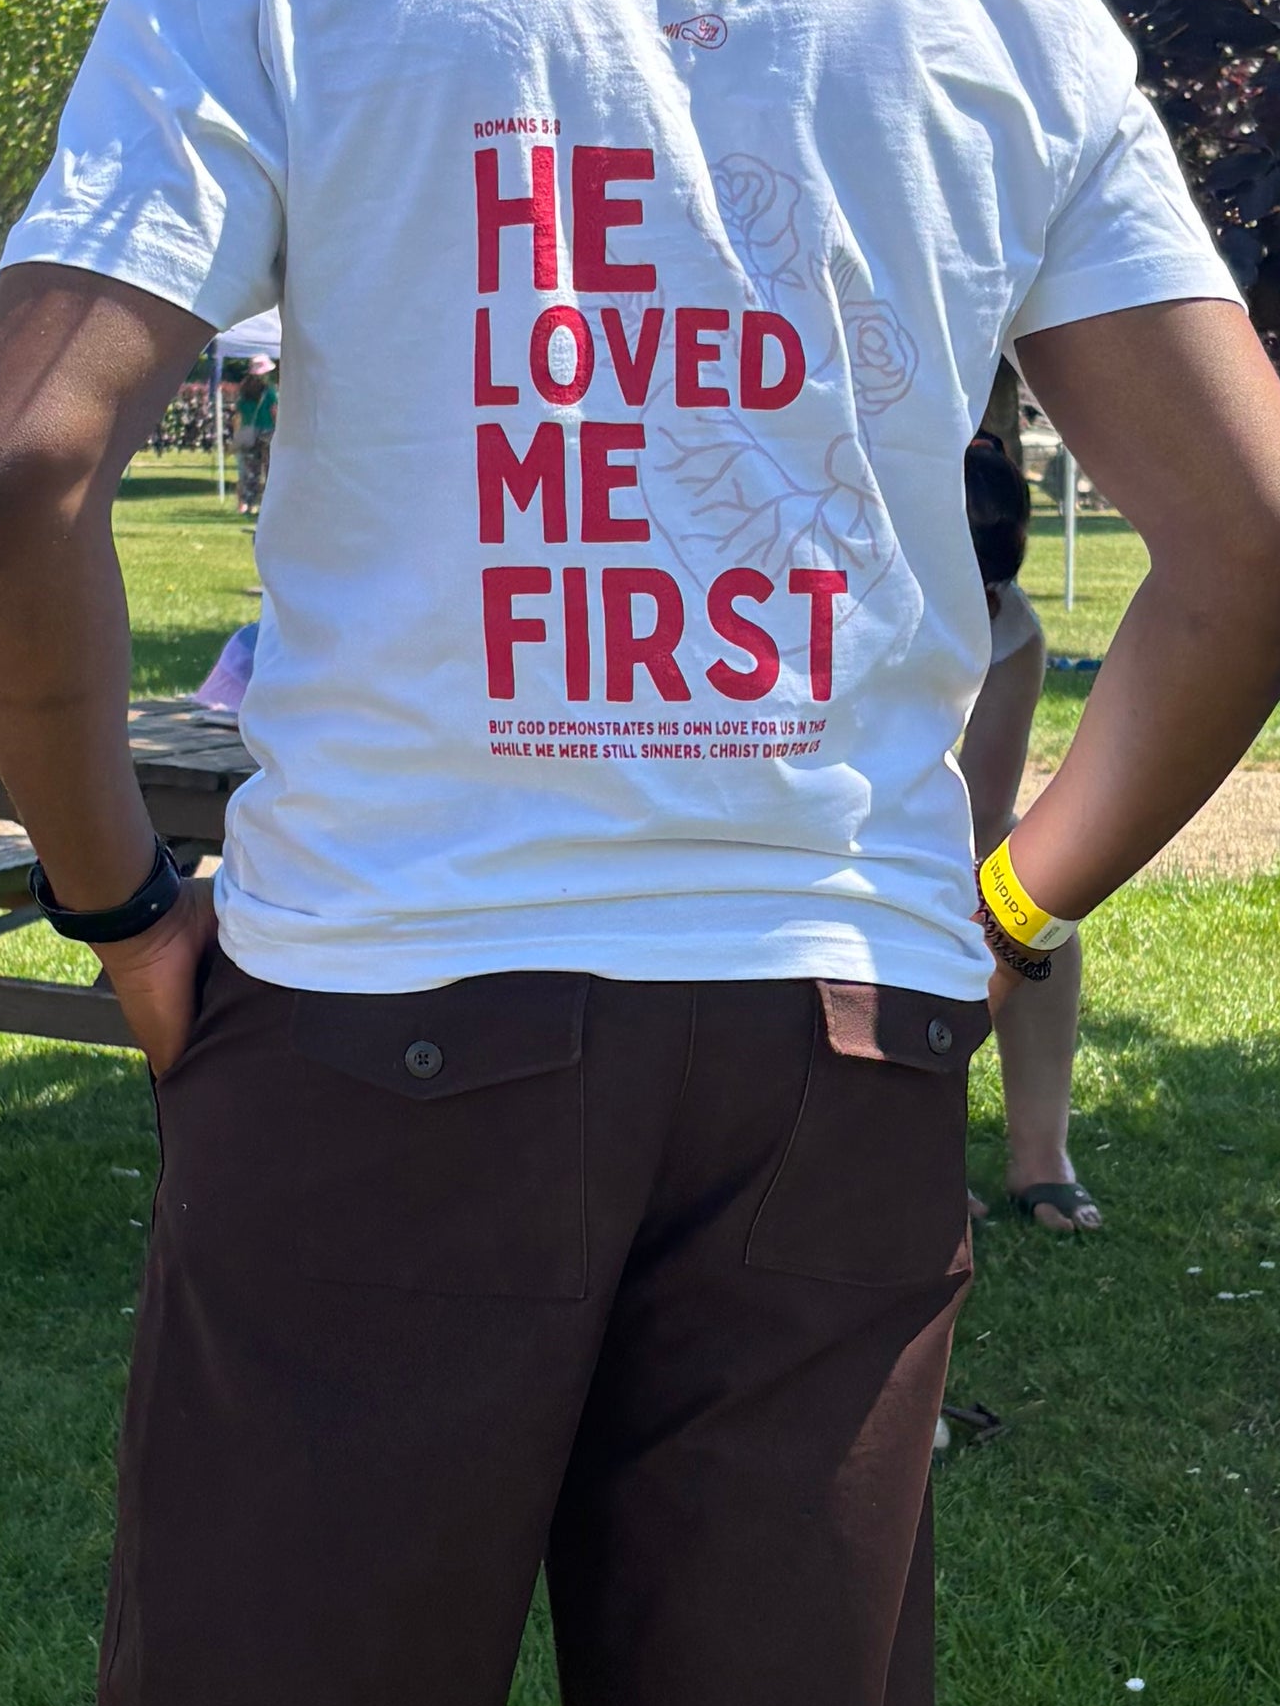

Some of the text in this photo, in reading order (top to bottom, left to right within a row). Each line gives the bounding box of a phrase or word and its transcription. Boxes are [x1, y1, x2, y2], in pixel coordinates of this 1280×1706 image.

[474, 117, 561, 139] ROMANS 5:8
[474, 145, 657, 293] HE
[473, 305, 806, 410] LOVED
[476, 422, 651, 544] ME
[481, 566, 848, 702] FIRST
[489, 720, 513, 734] BUT
[518, 720, 545, 735] GOD
[549, 721, 655, 735] DEMONSTRATES
[658, 721, 679, 735] HIS
[683, 721, 712, 735] OWN
[715, 721, 748, 735] LOVE
[752, 721, 777, 735] FOR
[780, 720, 794, 734] US
[797, 721, 806, 734] IN
[491, 740, 820, 760] WHILE WE WERE STILL SINNERS, CHRIST DIED FOR US
